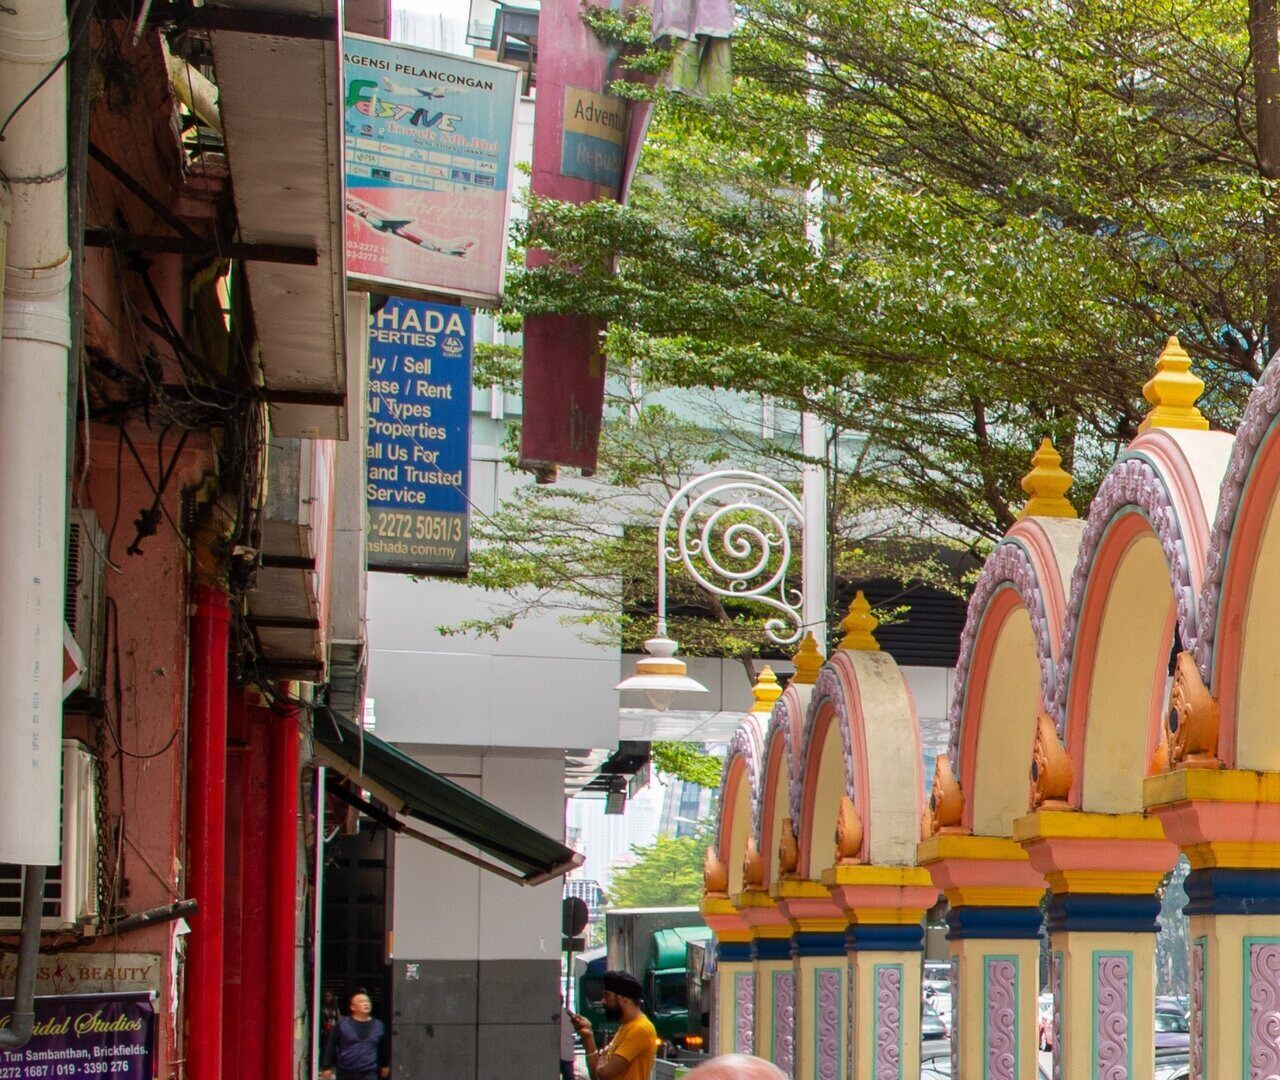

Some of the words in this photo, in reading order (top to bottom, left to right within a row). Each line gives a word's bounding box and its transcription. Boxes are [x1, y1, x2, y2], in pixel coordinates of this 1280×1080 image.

[395, 63, 493, 91] PELANCONGAN
[392, 355, 398, 372] /
[404, 356, 432, 375] Sell
[406, 379, 411, 395] /
[416, 380, 452, 399] Rent
[386, 398, 432, 419] Types
[387, 443, 408, 460] Us
[413, 446, 440, 463] For
[369, 465, 398, 480] and
[404, 465, 462, 486] Trusted
[367, 484, 426, 504] Service
[416, 515, 462, 541] 5051/3
[79, 965, 153, 981] BEAUTY
[74, 1009, 142, 1039] Studios
[4, 1051, 23, 1062] Tun
[25, 1047, 91, 1061] Sambanthan,
[94, 1044, 149, 1057] Brickfields.
[24, 1065, 48, 1077] 1687
[57, 1064, 75, 1075] 019
[83, 1062, 108, 1074] 3390
[110, 1060, 129, 1072] 276
